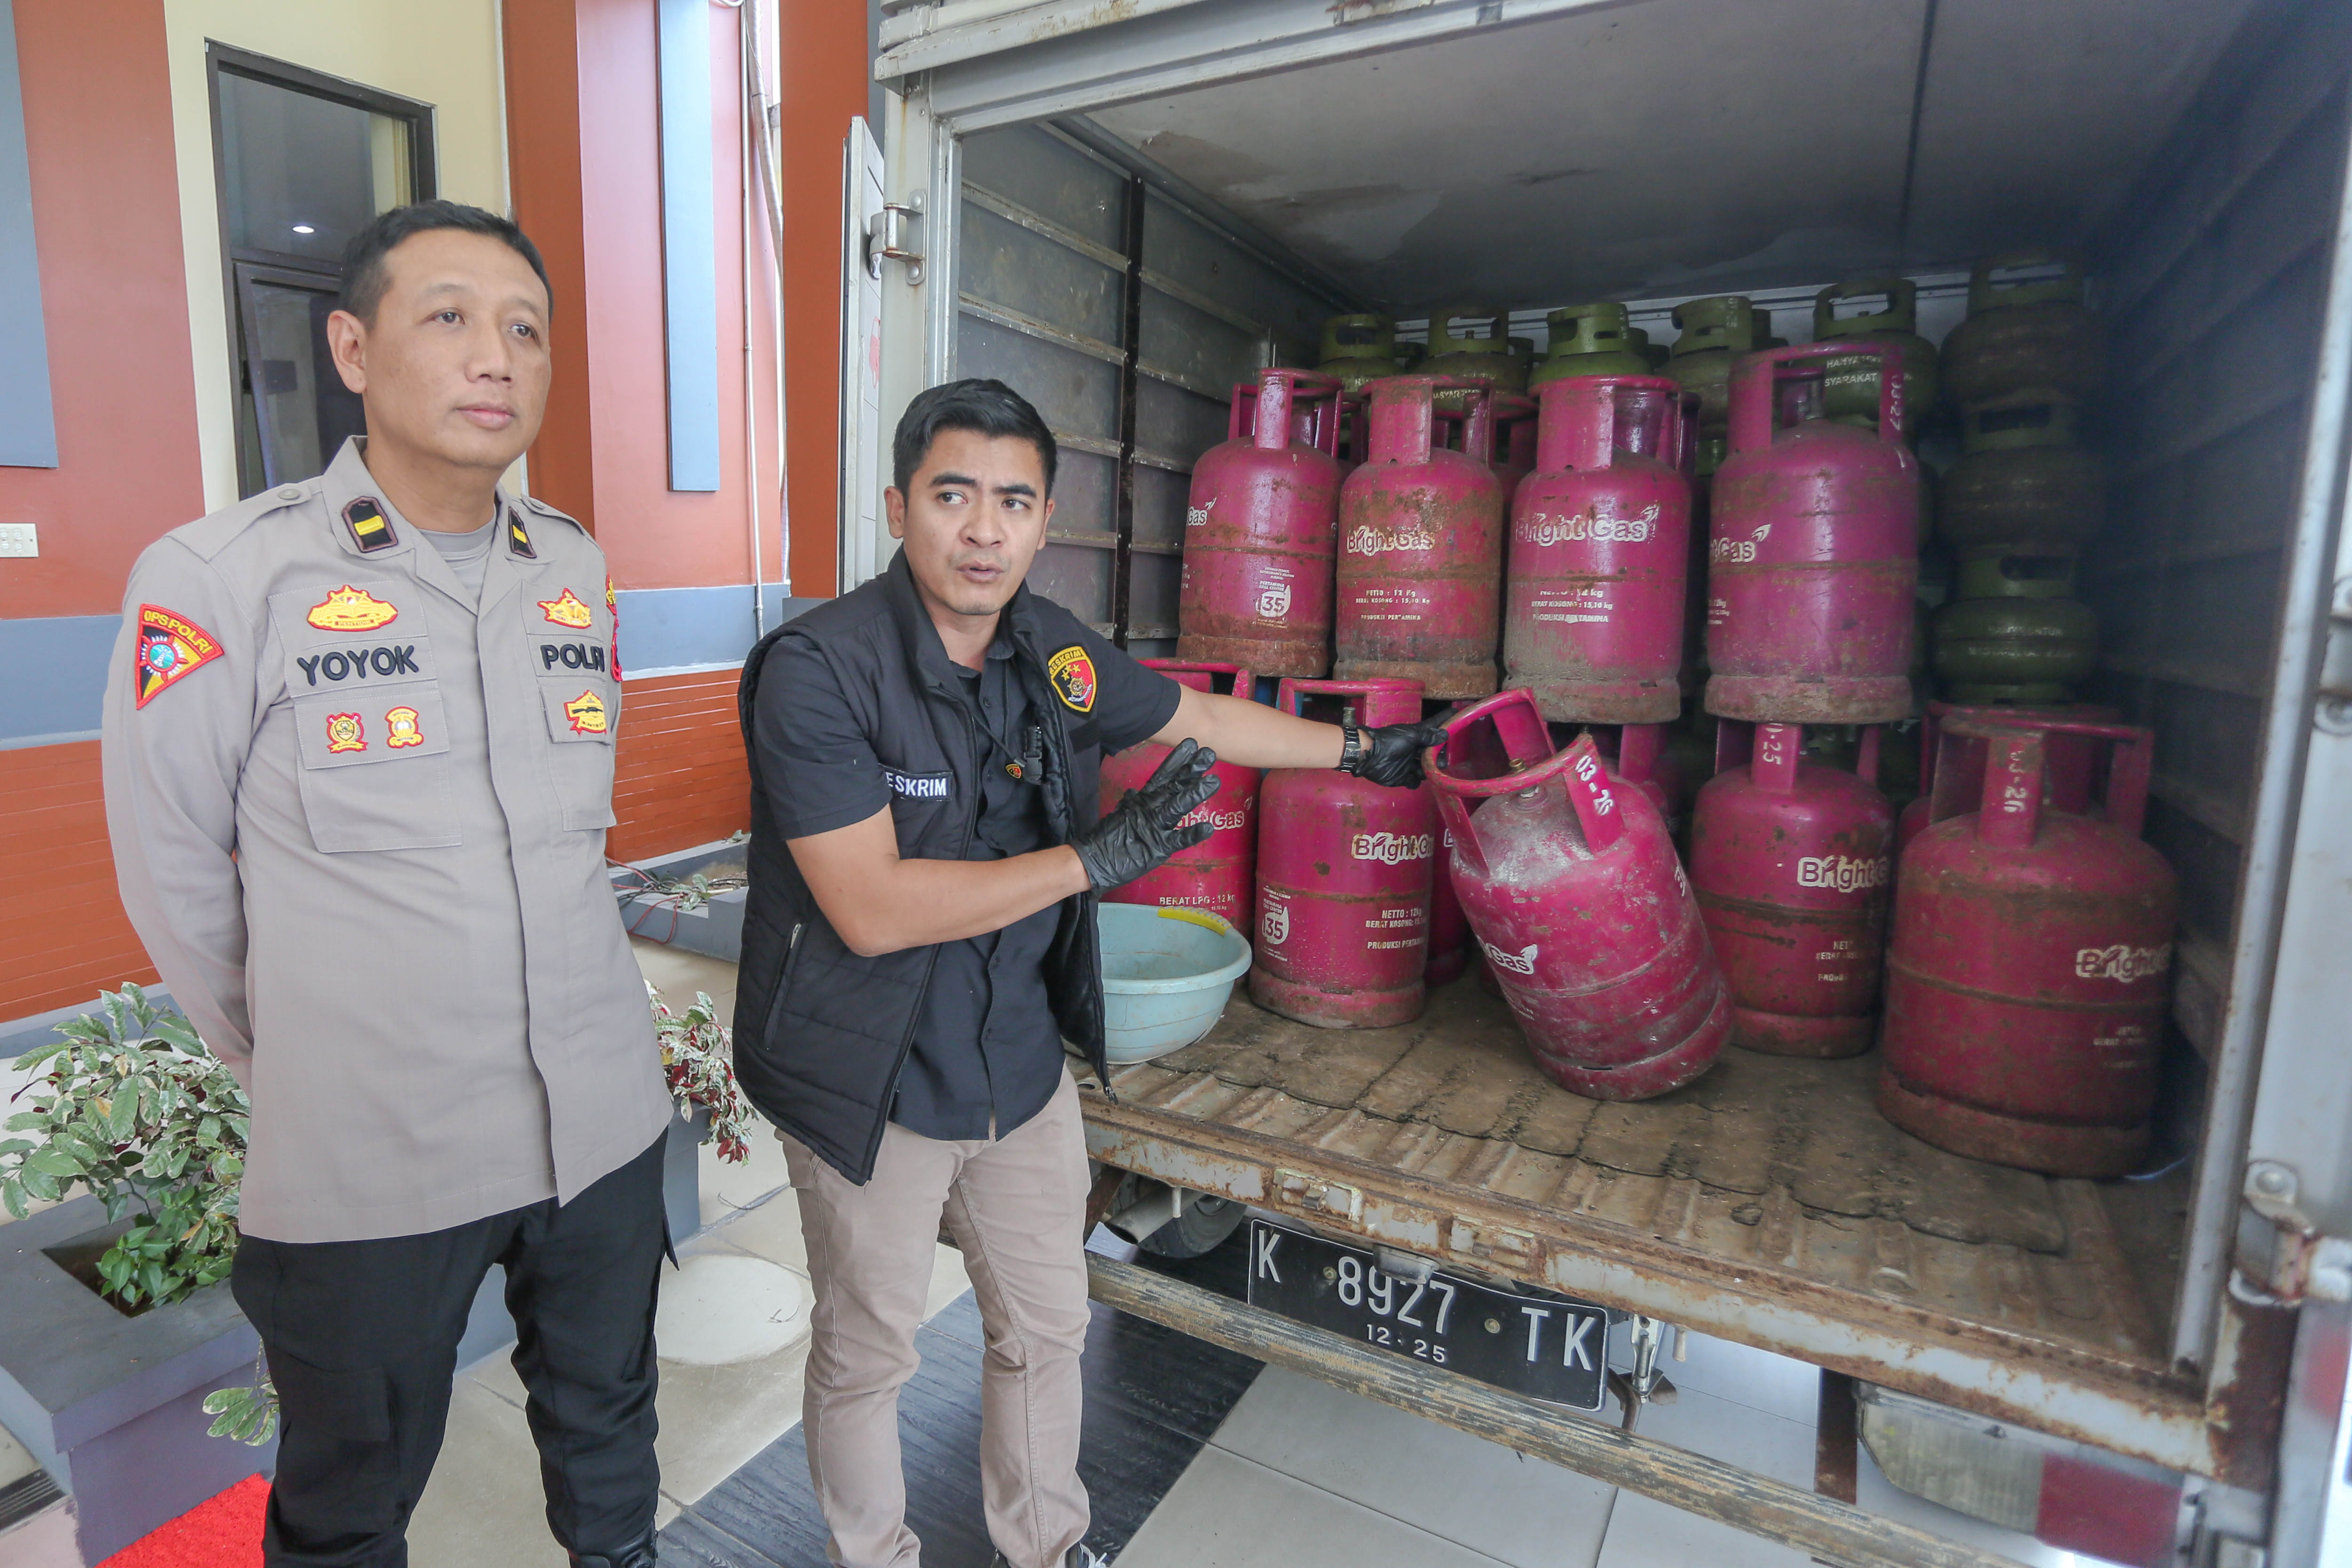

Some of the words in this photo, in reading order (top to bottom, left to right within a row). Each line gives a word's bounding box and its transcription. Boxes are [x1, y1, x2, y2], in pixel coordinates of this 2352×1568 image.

[1825, 372, 1877, 387] SYARAKAT
[1588, 514, 1647, 542] Gas
[143, 610, 169, 626] OPS
[167, 619, 213, 654] POLRI
[297, 645, 419, 686] YOYOK
[540, 643, 605, 672] POLRI
[1049, 650, 1082, 675] RESKRIM
[885, 772, 947, 797] ESKRIM
[1575, 755, 1614, 816] 03-26
[1209, 810, 1245, 830] Gas
[1351, 832, 1417, 865] Bright
[1159, 897, 1191, 905] BERAT
[1192, 896, 1210, 905] LPG
[1217, 894, 1227, 903] 12
[1382, 909, 1405, 919] NETTO
[1486, 942, 1534, 975] Gas
[1258, 1229, 1281, 1283] K
[1337, 1256, 1456, 1334] 8927
[1521, 1305, 1594, 1372] TK
